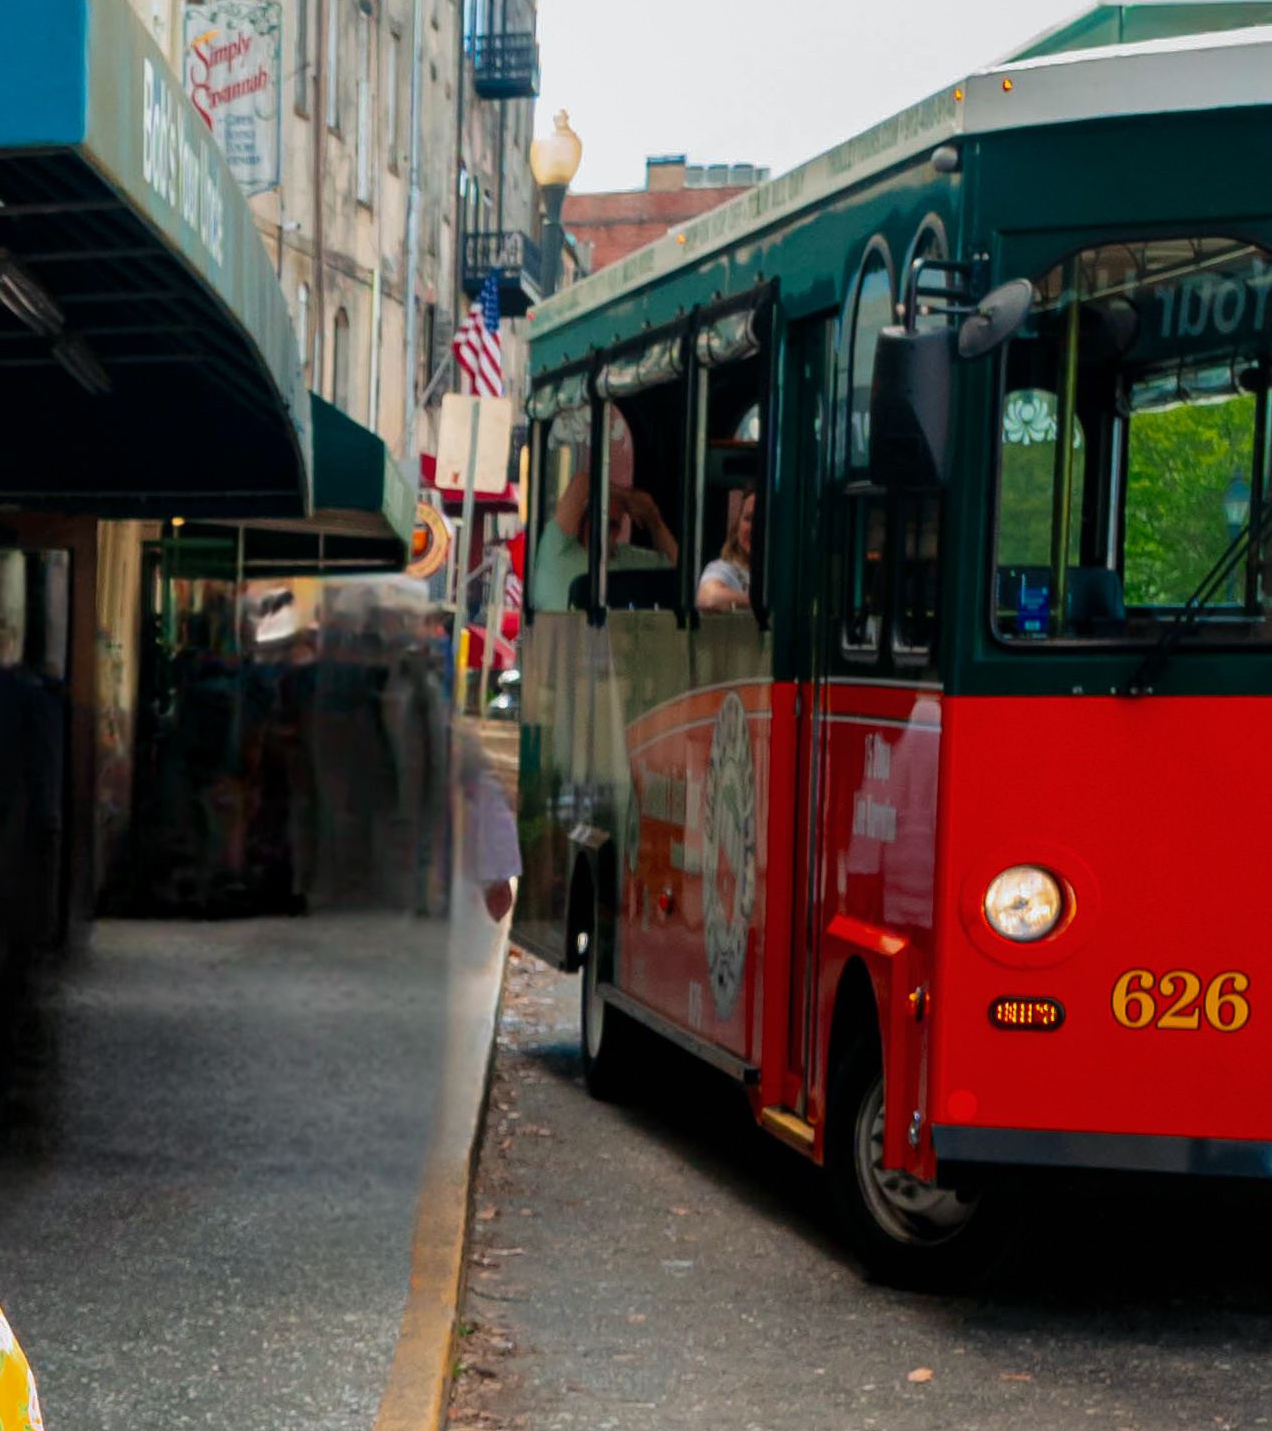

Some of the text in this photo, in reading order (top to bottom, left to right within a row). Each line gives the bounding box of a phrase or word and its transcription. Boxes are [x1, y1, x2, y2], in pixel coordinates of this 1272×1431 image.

[191, 30, 252, 83] Simply
[191, 66, 269, 132] Savannah
[1111, 968, 1250, 1033] 626
